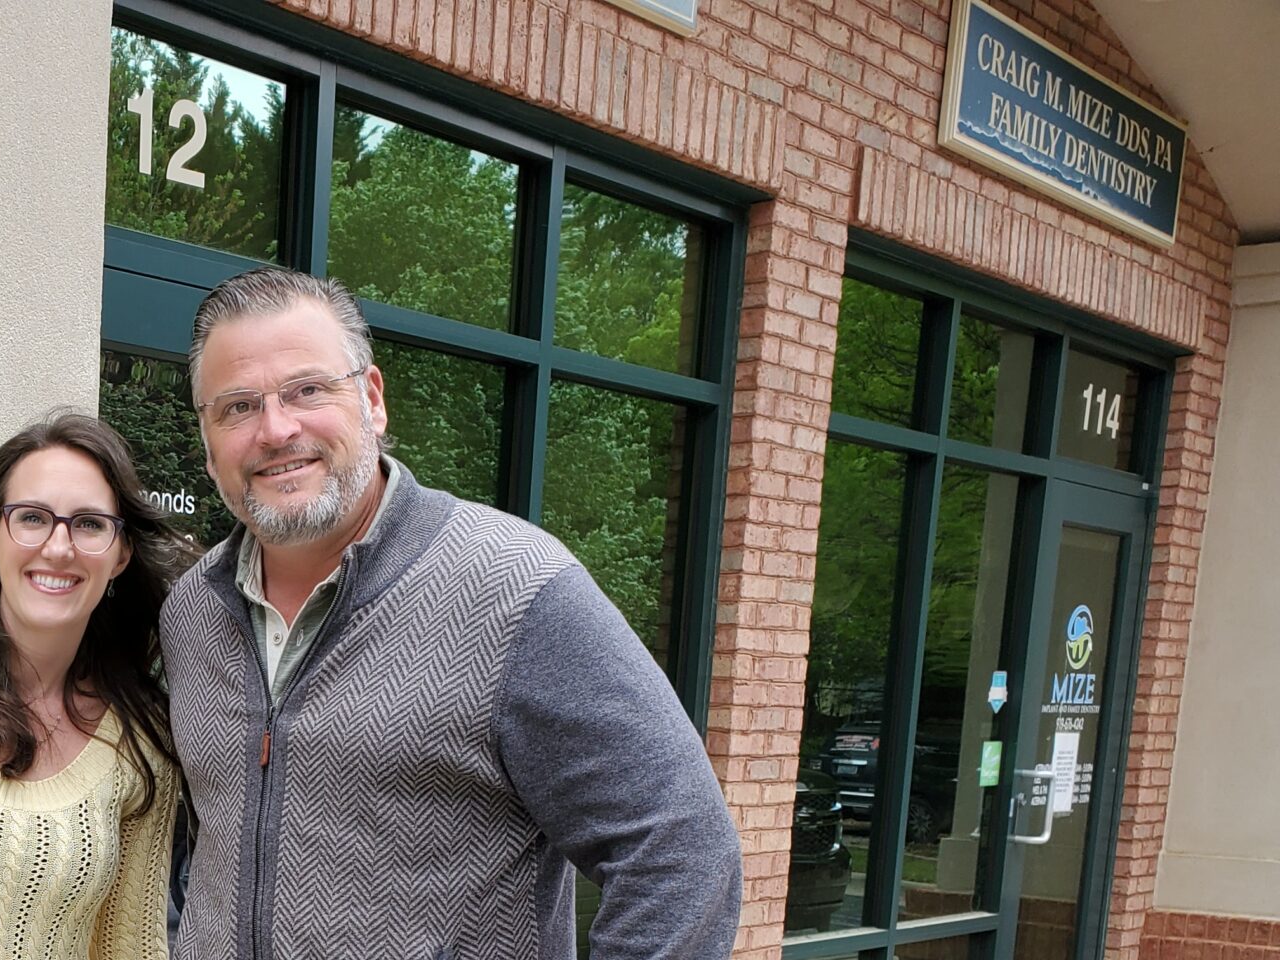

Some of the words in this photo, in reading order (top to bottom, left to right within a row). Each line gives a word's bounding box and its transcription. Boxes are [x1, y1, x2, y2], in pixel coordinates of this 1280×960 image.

[977, 33, 1041, 98] CRAIG
[1043, 70, 1064, 113] M.
[1066, 84, 1113, 138] MIZE
[1116, 112, 1151, 167] DDS,
[1154, 134, 1173, 173] PA
[988, 92, 1062, 160] FAMILY
[1063, 131, 1158, 208] DENTISTRY
[1083, 383, 1121, 440] 114
[1051, 672, 1096, 704] MIZE
